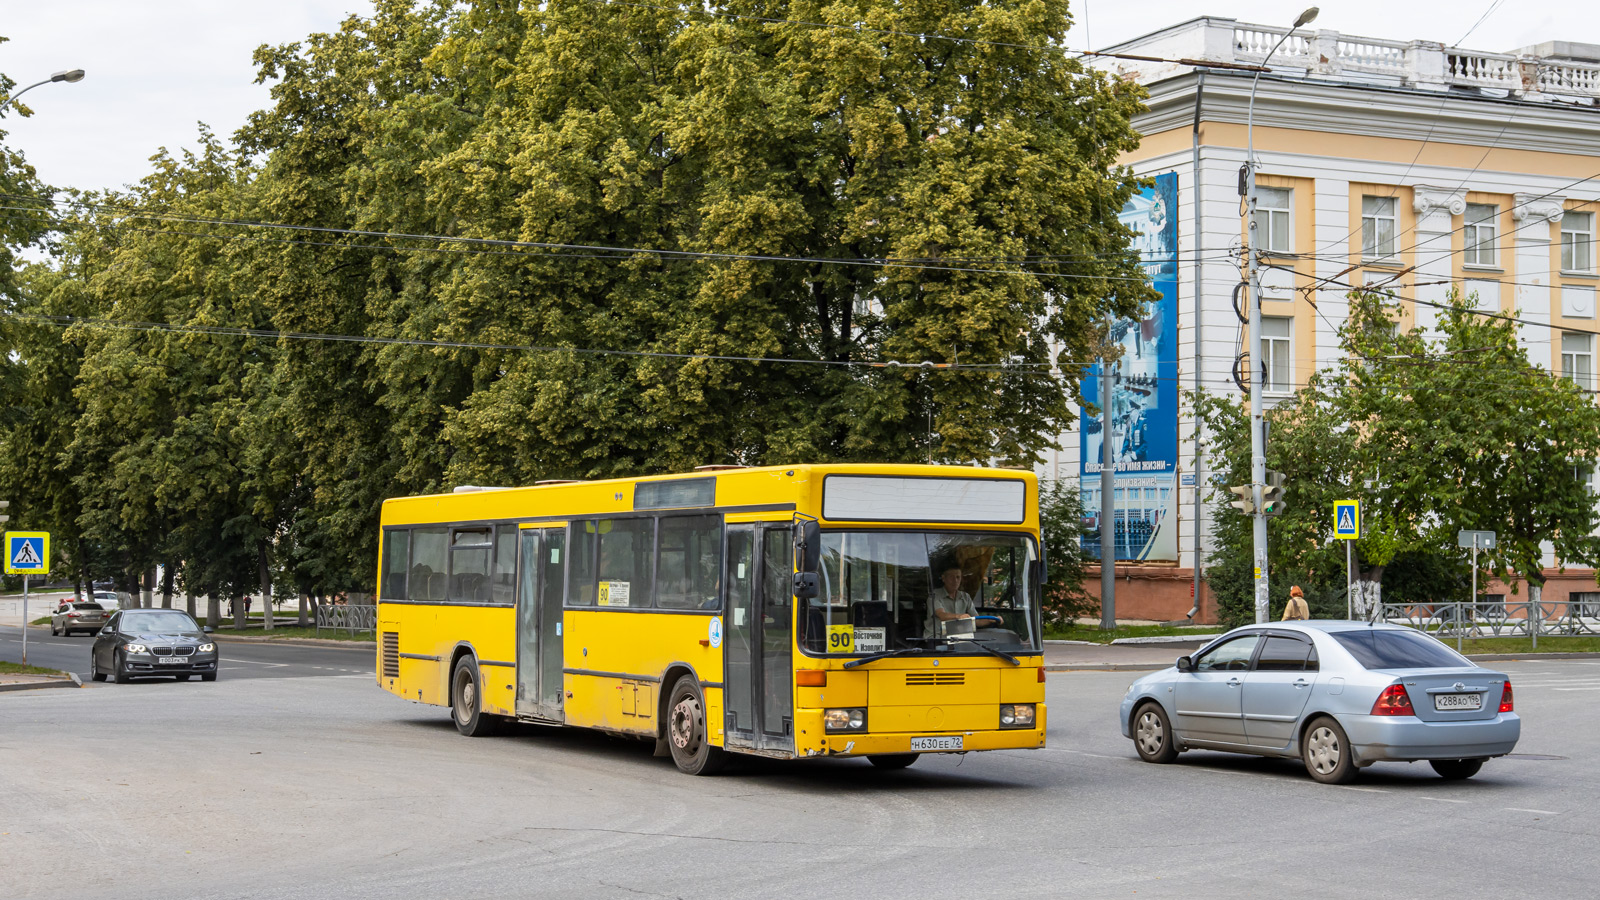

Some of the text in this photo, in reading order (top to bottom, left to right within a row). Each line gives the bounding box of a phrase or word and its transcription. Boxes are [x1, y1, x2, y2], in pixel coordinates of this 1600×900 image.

[1085, 462, 1117, 473] Спасее
[1118, 463, 1126, 472] во
[1127, 462, 1141, 471] имя
[1142, 460, 1165, 470] жизни
[1118, 475, 1157, 488] призвание!
[600, 588, 608, 601] 90
[830, 632, 850, 648] 90
